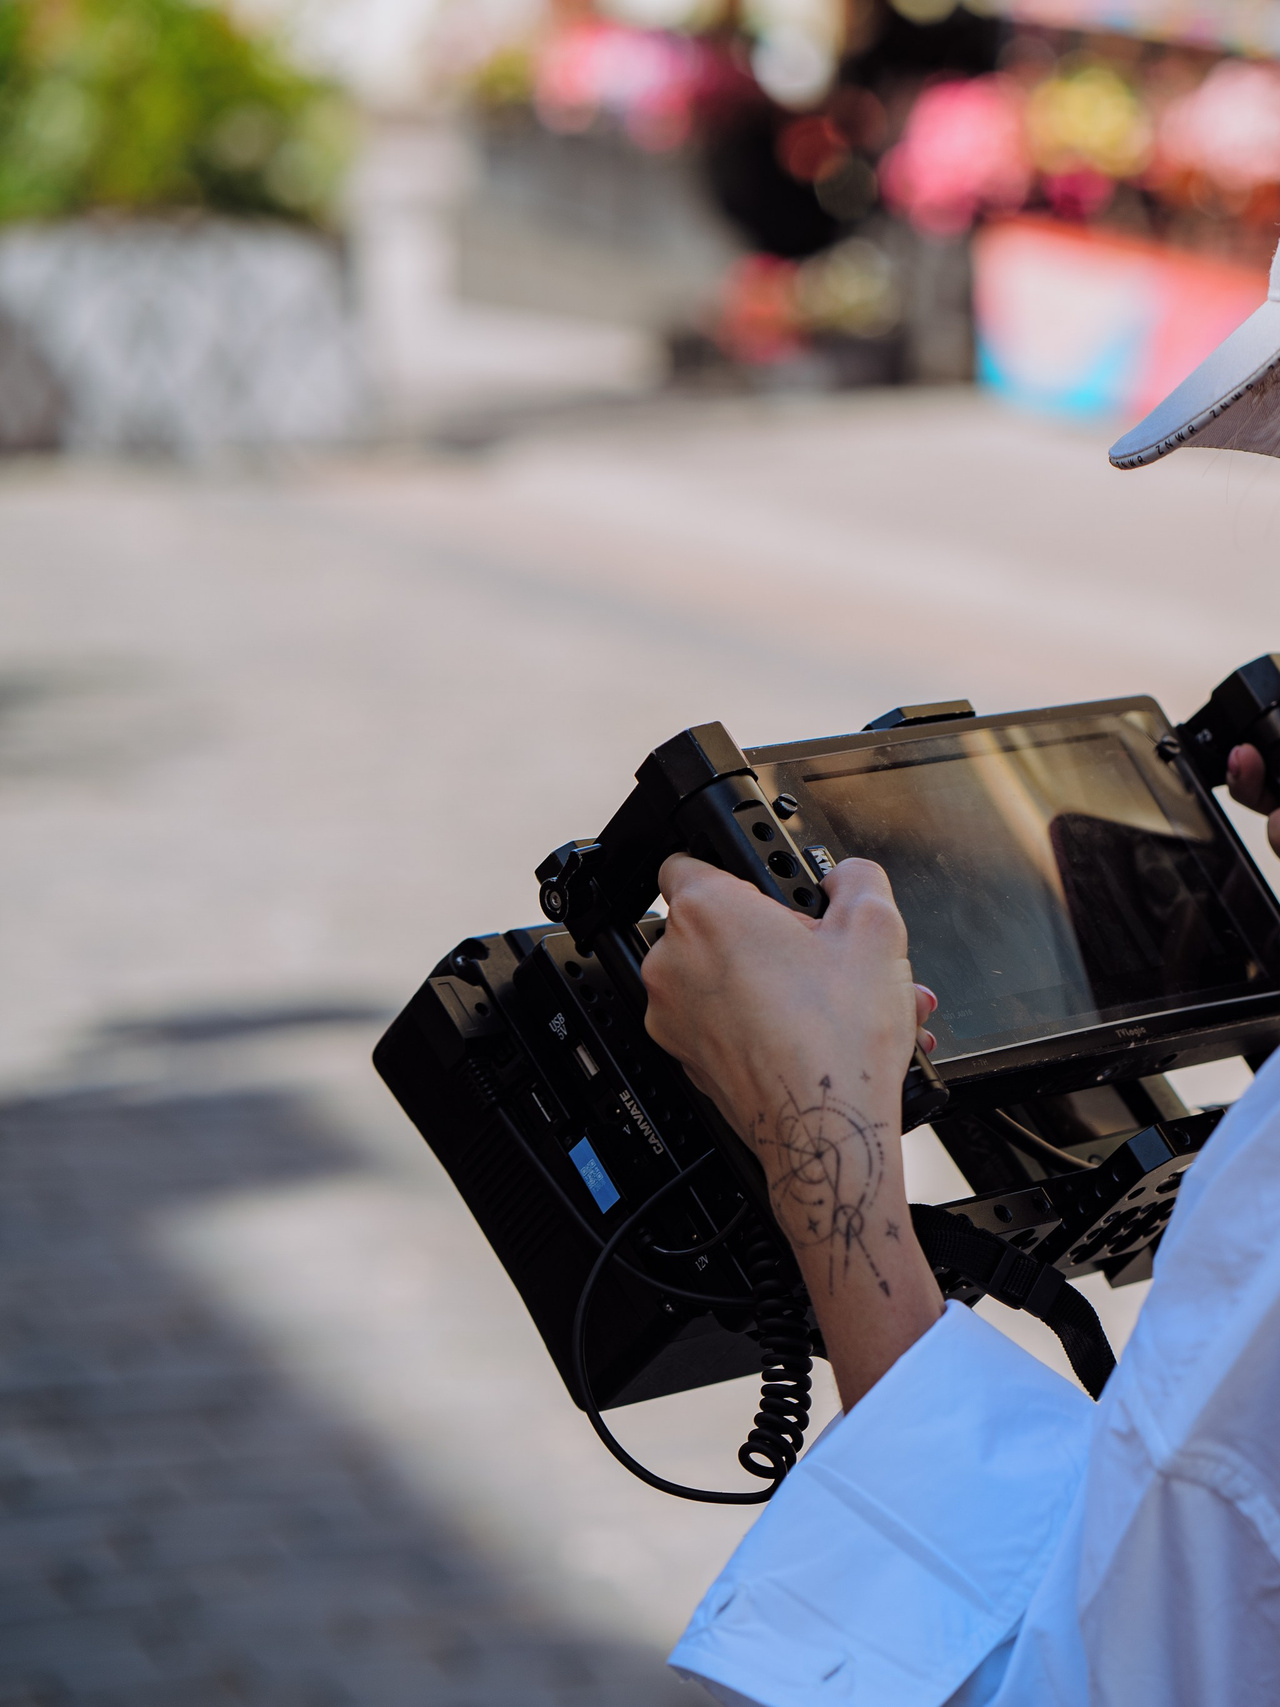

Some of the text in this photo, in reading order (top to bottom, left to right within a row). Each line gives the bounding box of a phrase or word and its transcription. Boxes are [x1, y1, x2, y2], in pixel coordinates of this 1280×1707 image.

[1155, 424, 1198, 455] ZNWR
[548, 1012, 566, 1033] USB
[556, 1024, 568, 1041] 5V
[618, 1089, 664, 1155] CAMVATE
[694, 1254, 709, 1272] 12V
